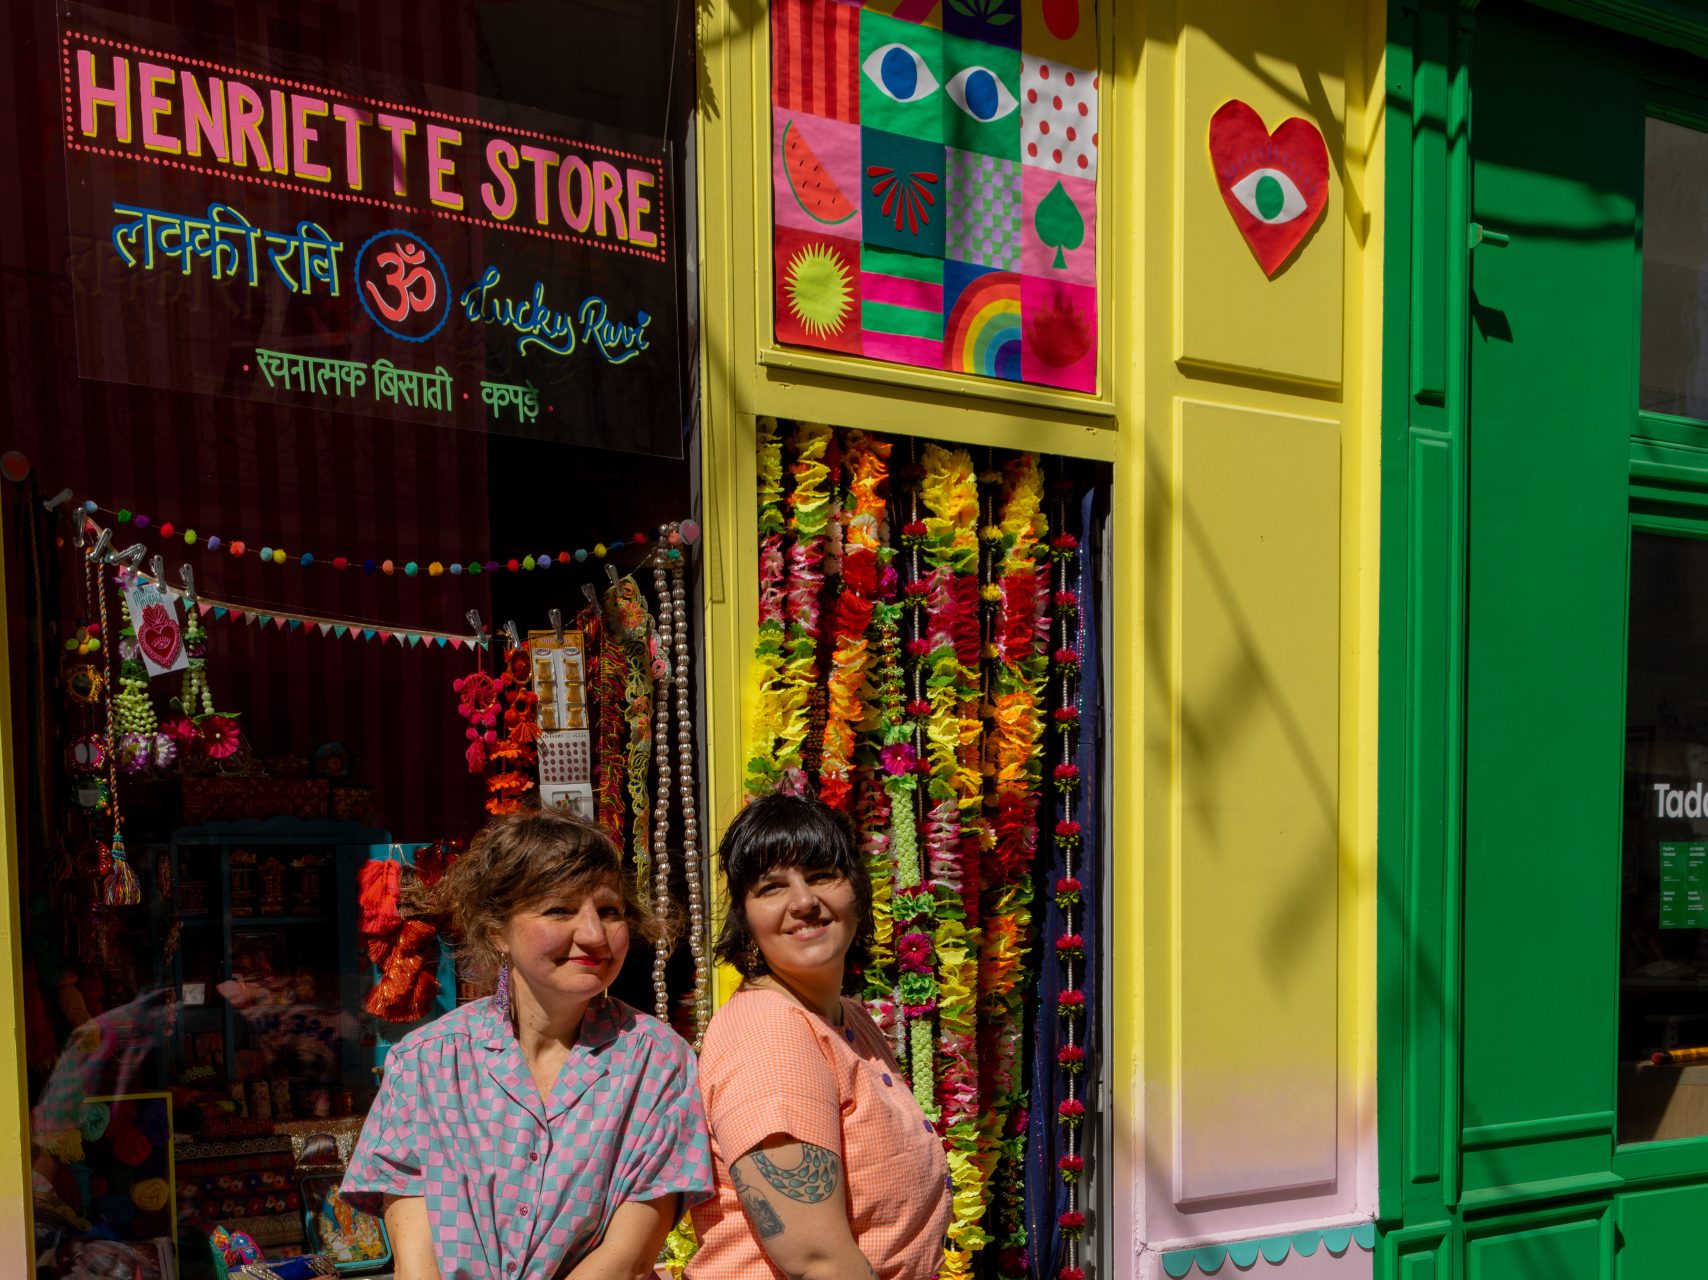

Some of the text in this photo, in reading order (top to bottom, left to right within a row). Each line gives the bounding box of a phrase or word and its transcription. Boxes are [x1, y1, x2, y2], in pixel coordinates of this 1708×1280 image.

[77, 49, 658, 248] HENRIETTE STORE
[264, 220, 343, 296] रवि
[461, 265, 651, 364] Lucky Ravi
[372, 358, 453, 411] बिसाती
